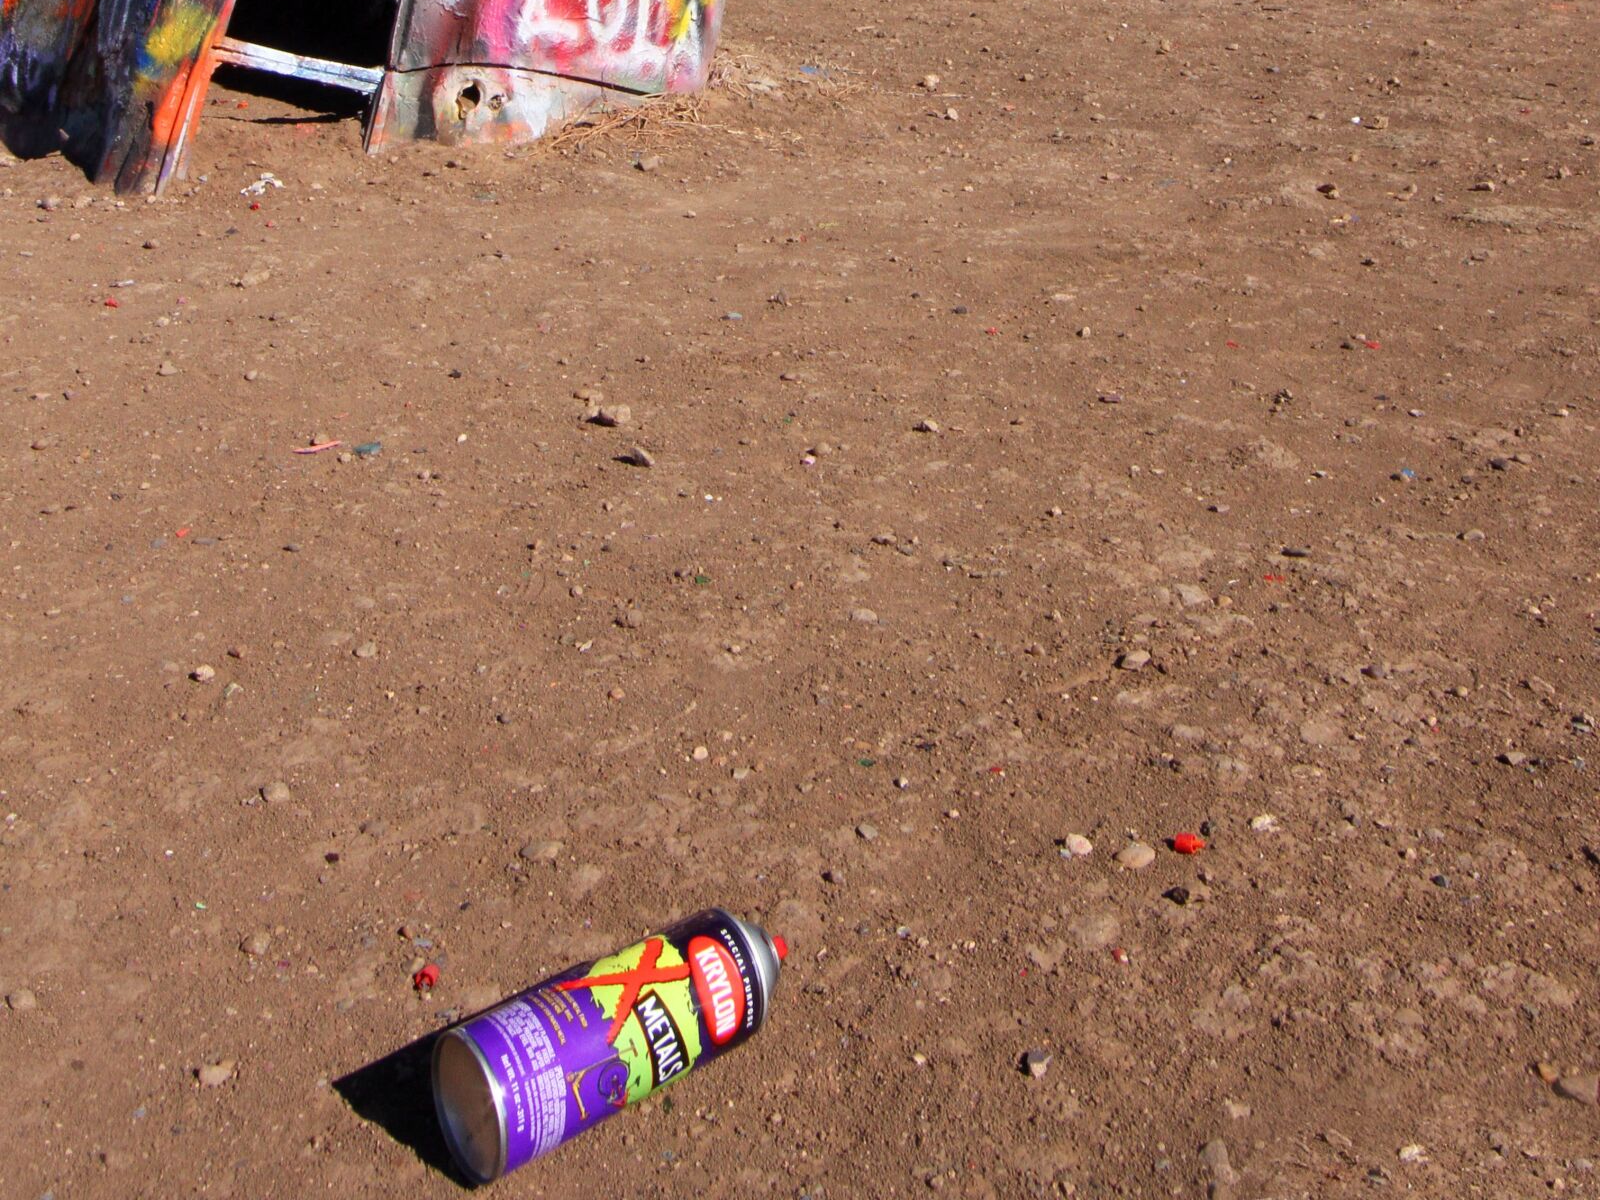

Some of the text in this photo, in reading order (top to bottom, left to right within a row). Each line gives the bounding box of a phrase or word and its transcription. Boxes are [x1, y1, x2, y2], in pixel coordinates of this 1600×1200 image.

[695, 945, 736, 1037] KRYLON
[720, 928, 755, 1029] SPECIAL PURPOSE
[637, 995, 684, 1082] METALS
